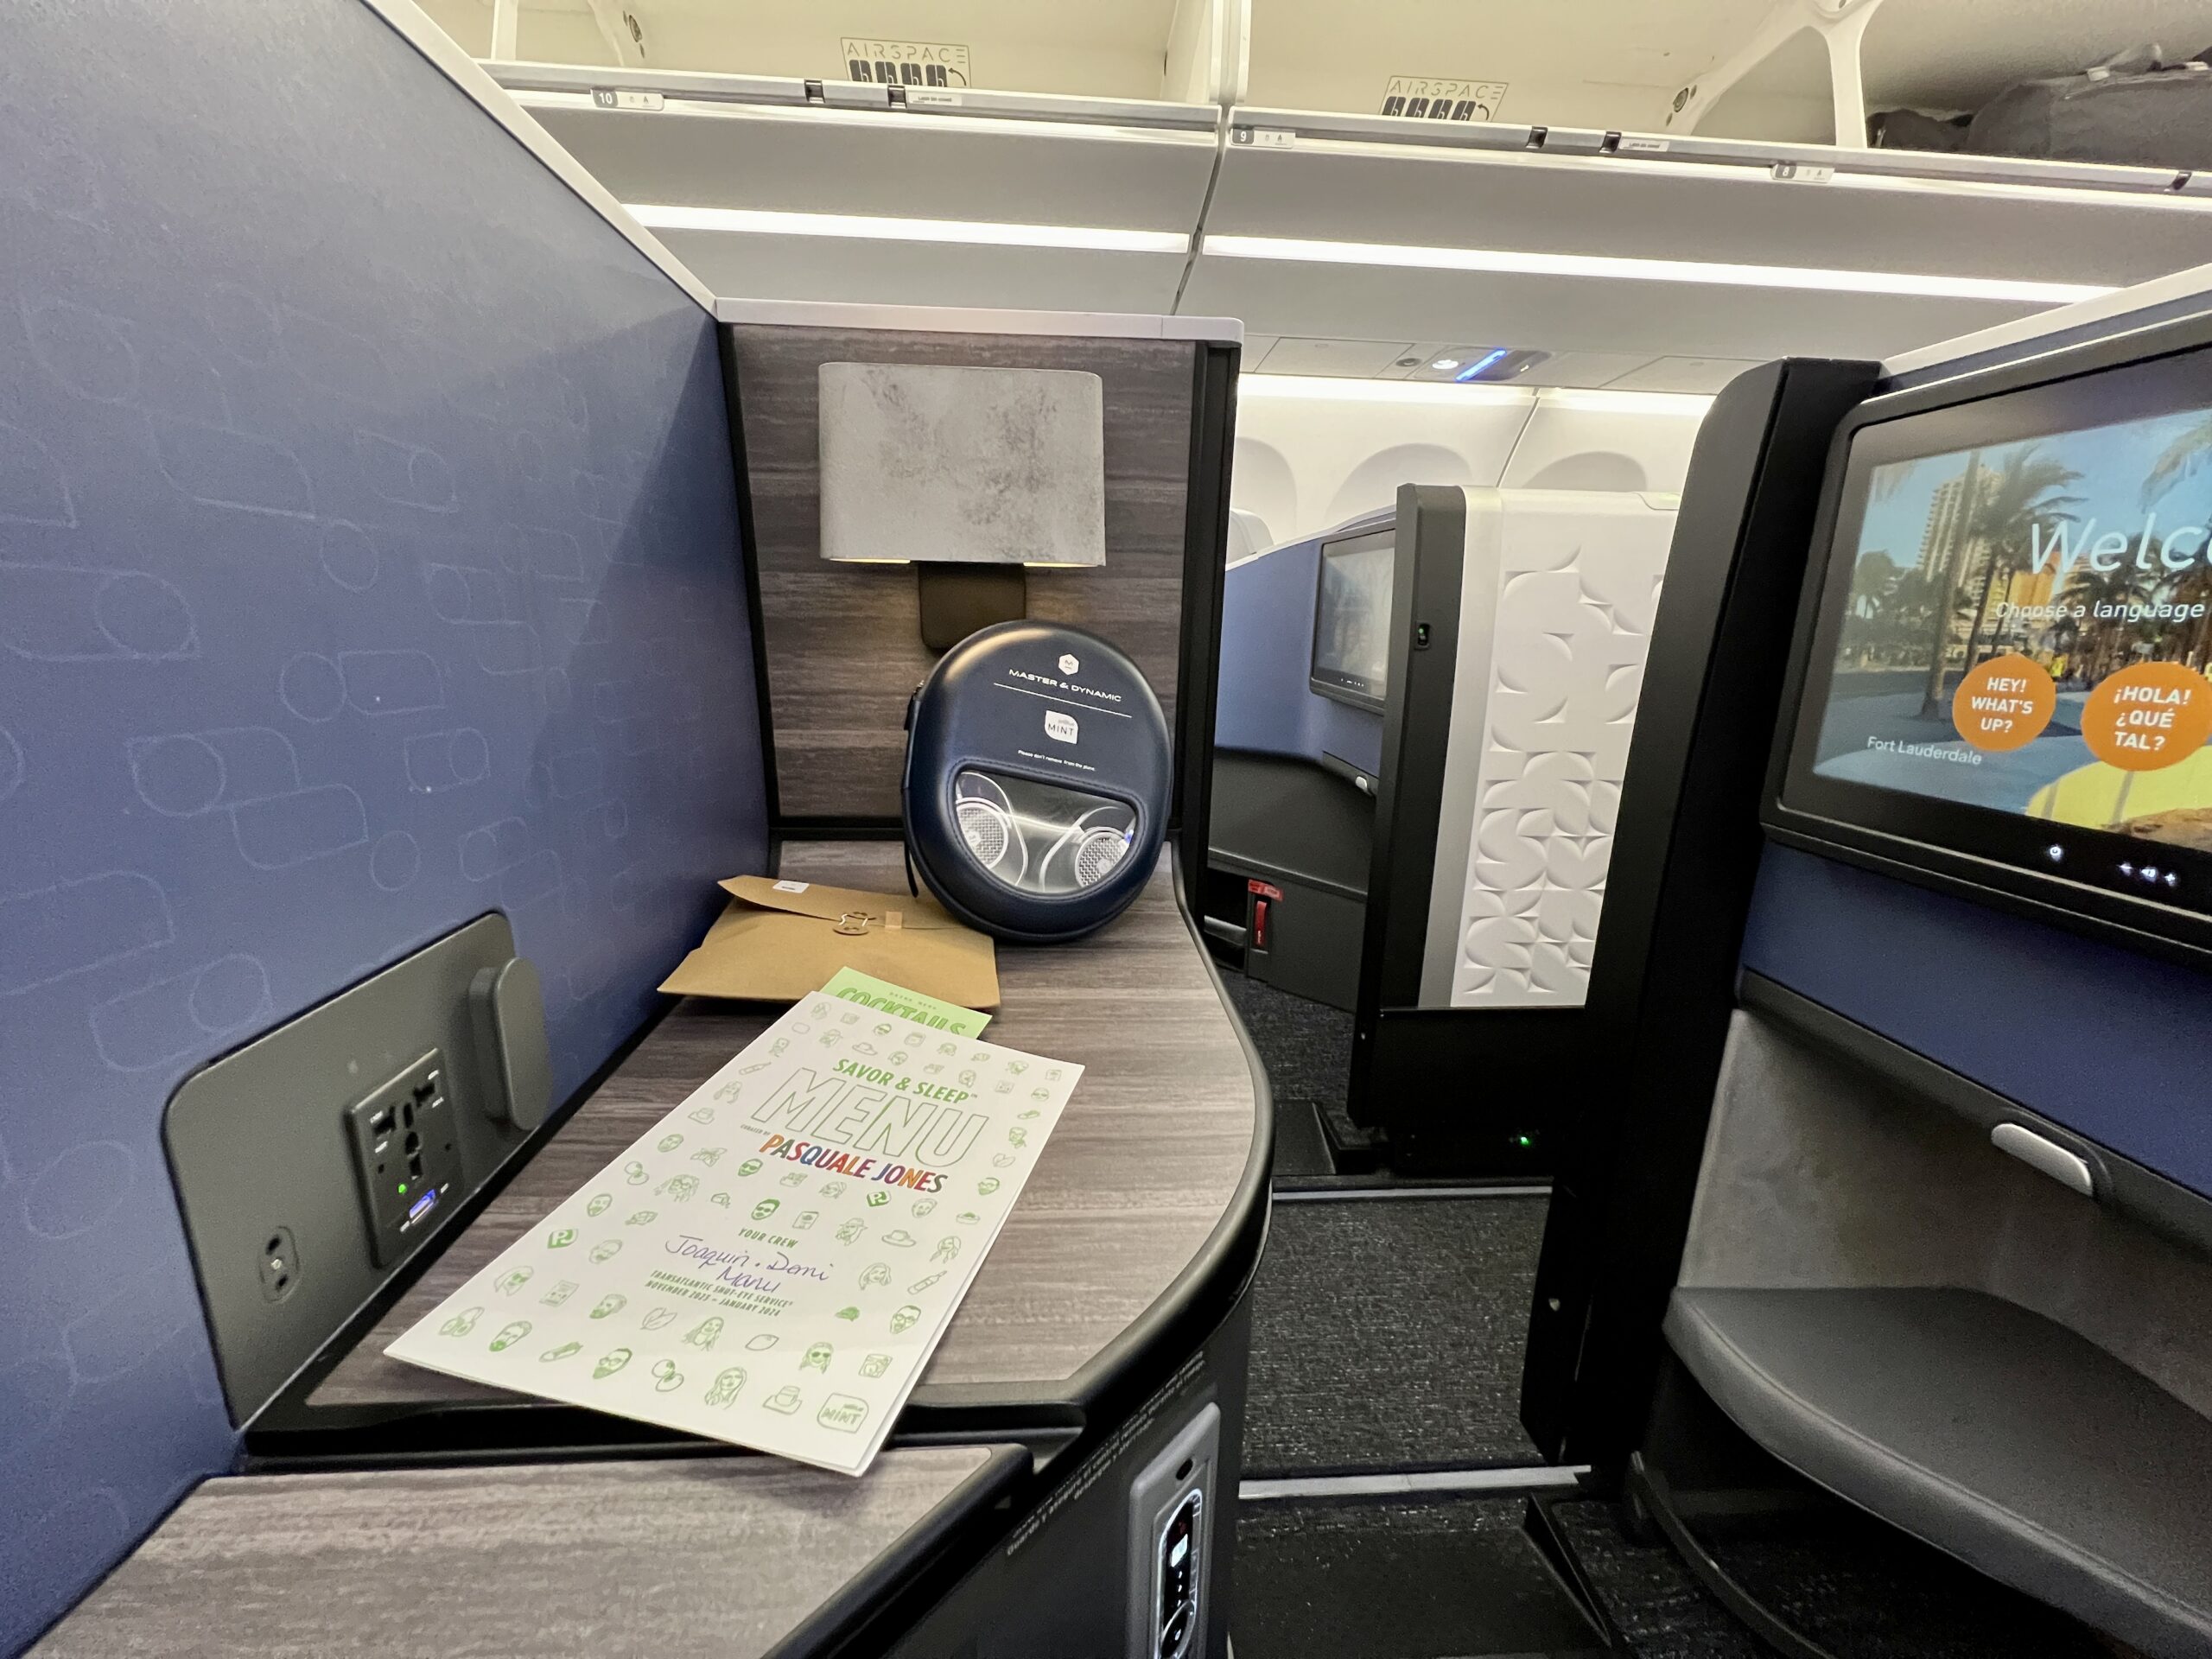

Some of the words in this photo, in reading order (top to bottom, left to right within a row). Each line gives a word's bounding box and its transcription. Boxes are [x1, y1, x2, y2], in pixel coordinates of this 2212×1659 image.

[847, 41, 966, 63] AIRSPACE
[598, 92, 613, 105] 10
[1389, 79, 1503, 100] AIRSPACE
[1240, 130, 1247, 143] 9
[1782, 166, 1790, 177] 8
[2031, 512, 2212, 575] Welc
[1995, 601, 2068, 619] Choose
[2073, 605, 2086, 618] a
[2093, 601, 2205, 623] language
[1008, 669, 1058, 687] MASTER
[1071, 684, 1122, 702] DYNAMIC
[1986, 677, 2027, 693] HEY!
[2113, 685, 2192, 706] ¡HOLA!
[1971, 696, 2034, 715] WHAT'S
[1047, 722, 1075, 736] MINT
[1980, 717, 2013, 734] UP?
[2115, 709, 2176, 728] ¿QUÉ
[1866, 735, 1896, 753] Fort
[1897, 740, 1982, 766] Lauderdale
[2114, 731, 2166, 752] TAL?
[832, 1058, 895, 1087] SAVOR
[895, 1077, 912, 1091] &
[750, 1067, 990, 1168] MENU
[759, 1134, 877, 1179] PASQUALE
[870, 1162, 949, 1193] JONES
[737, 1227, 767, 1243] YOUR
[767, 1234, 799, 1249] CREW
[664, 1234, 750, 1269] Joaquin
[650, 1269, 714, 1292] TRANSATLANTIC
[713, 1284, 753, 1300] SHUT-EYE
[644, 1279, 690, 1296] NOVEMBER
[688, 1290, 712, 1302] 2023
[718, 1297, 759, 1313] JANUARY
[757, 1306, 781, 1318] 2024
[820, 1407, 861, 1425] MINT
